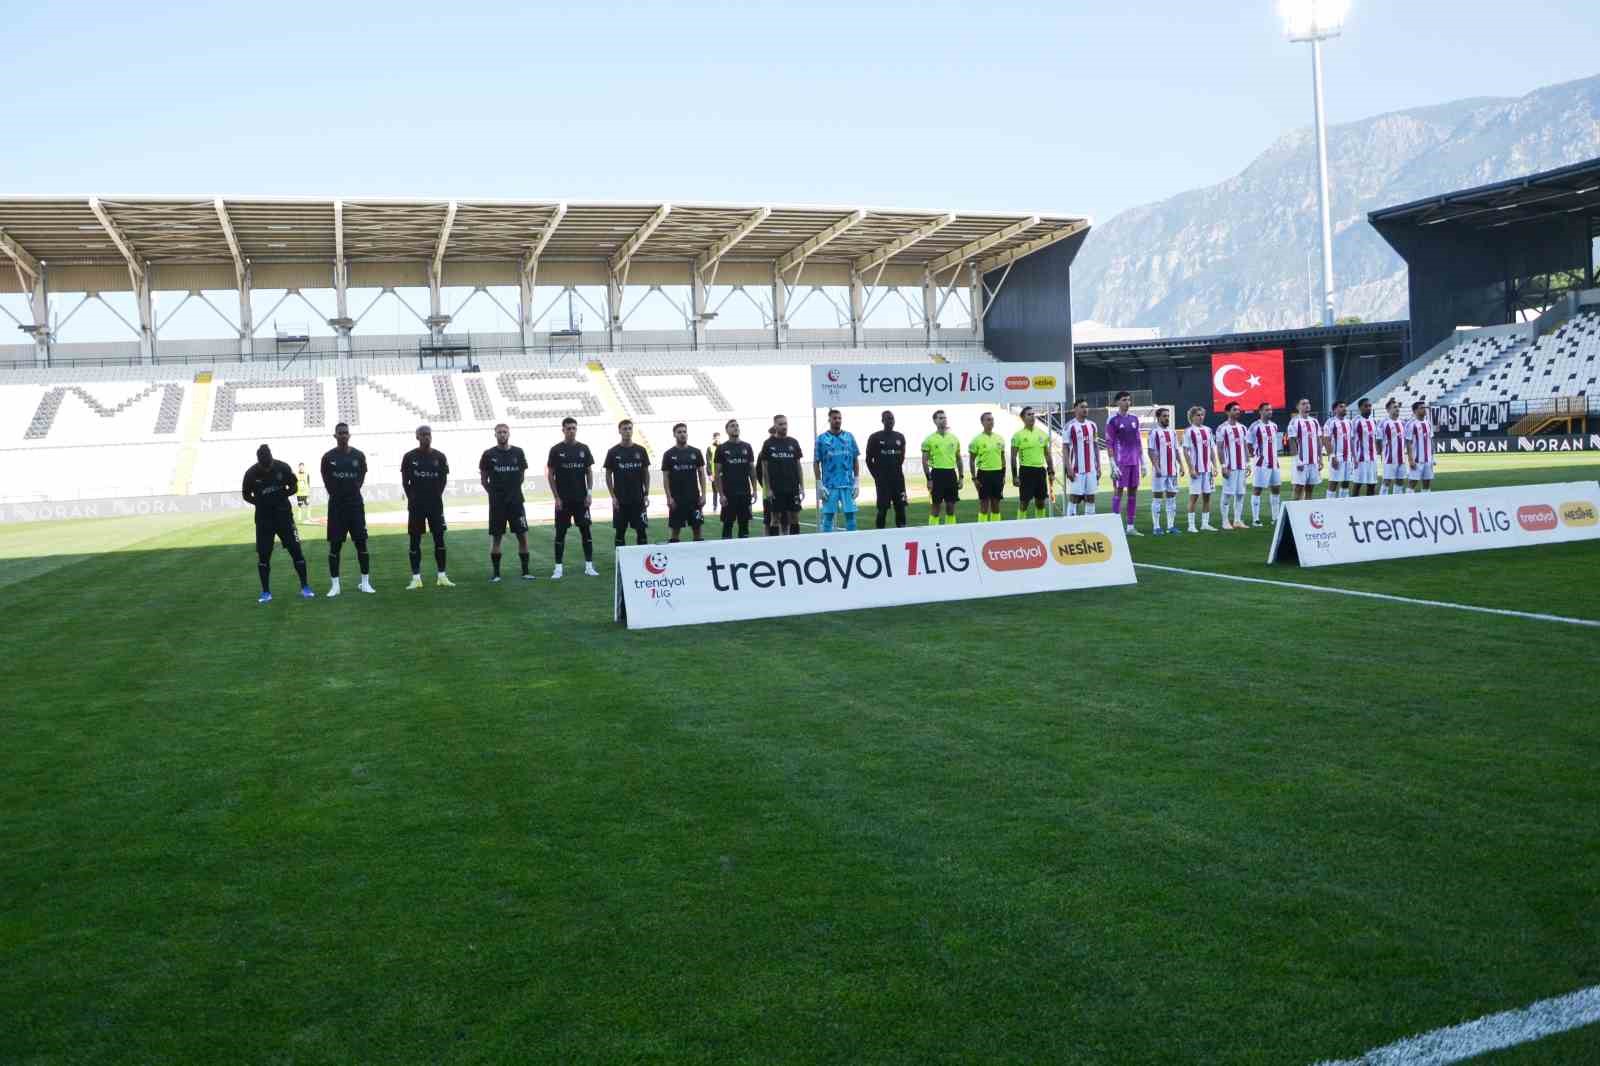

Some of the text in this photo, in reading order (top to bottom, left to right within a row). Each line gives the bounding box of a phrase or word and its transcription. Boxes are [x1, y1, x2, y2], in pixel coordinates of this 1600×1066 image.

[858, 372, 953, 397] trendyol
[1461, 402, 1509, 426] KAZAN
[1349, 507, 1464, 543] trendyol
[988, 539, 1105, 561] trendyol NESİNE
[706, 544, 892, 592] trendyol
[634, 575, 685, 588] trendyol
